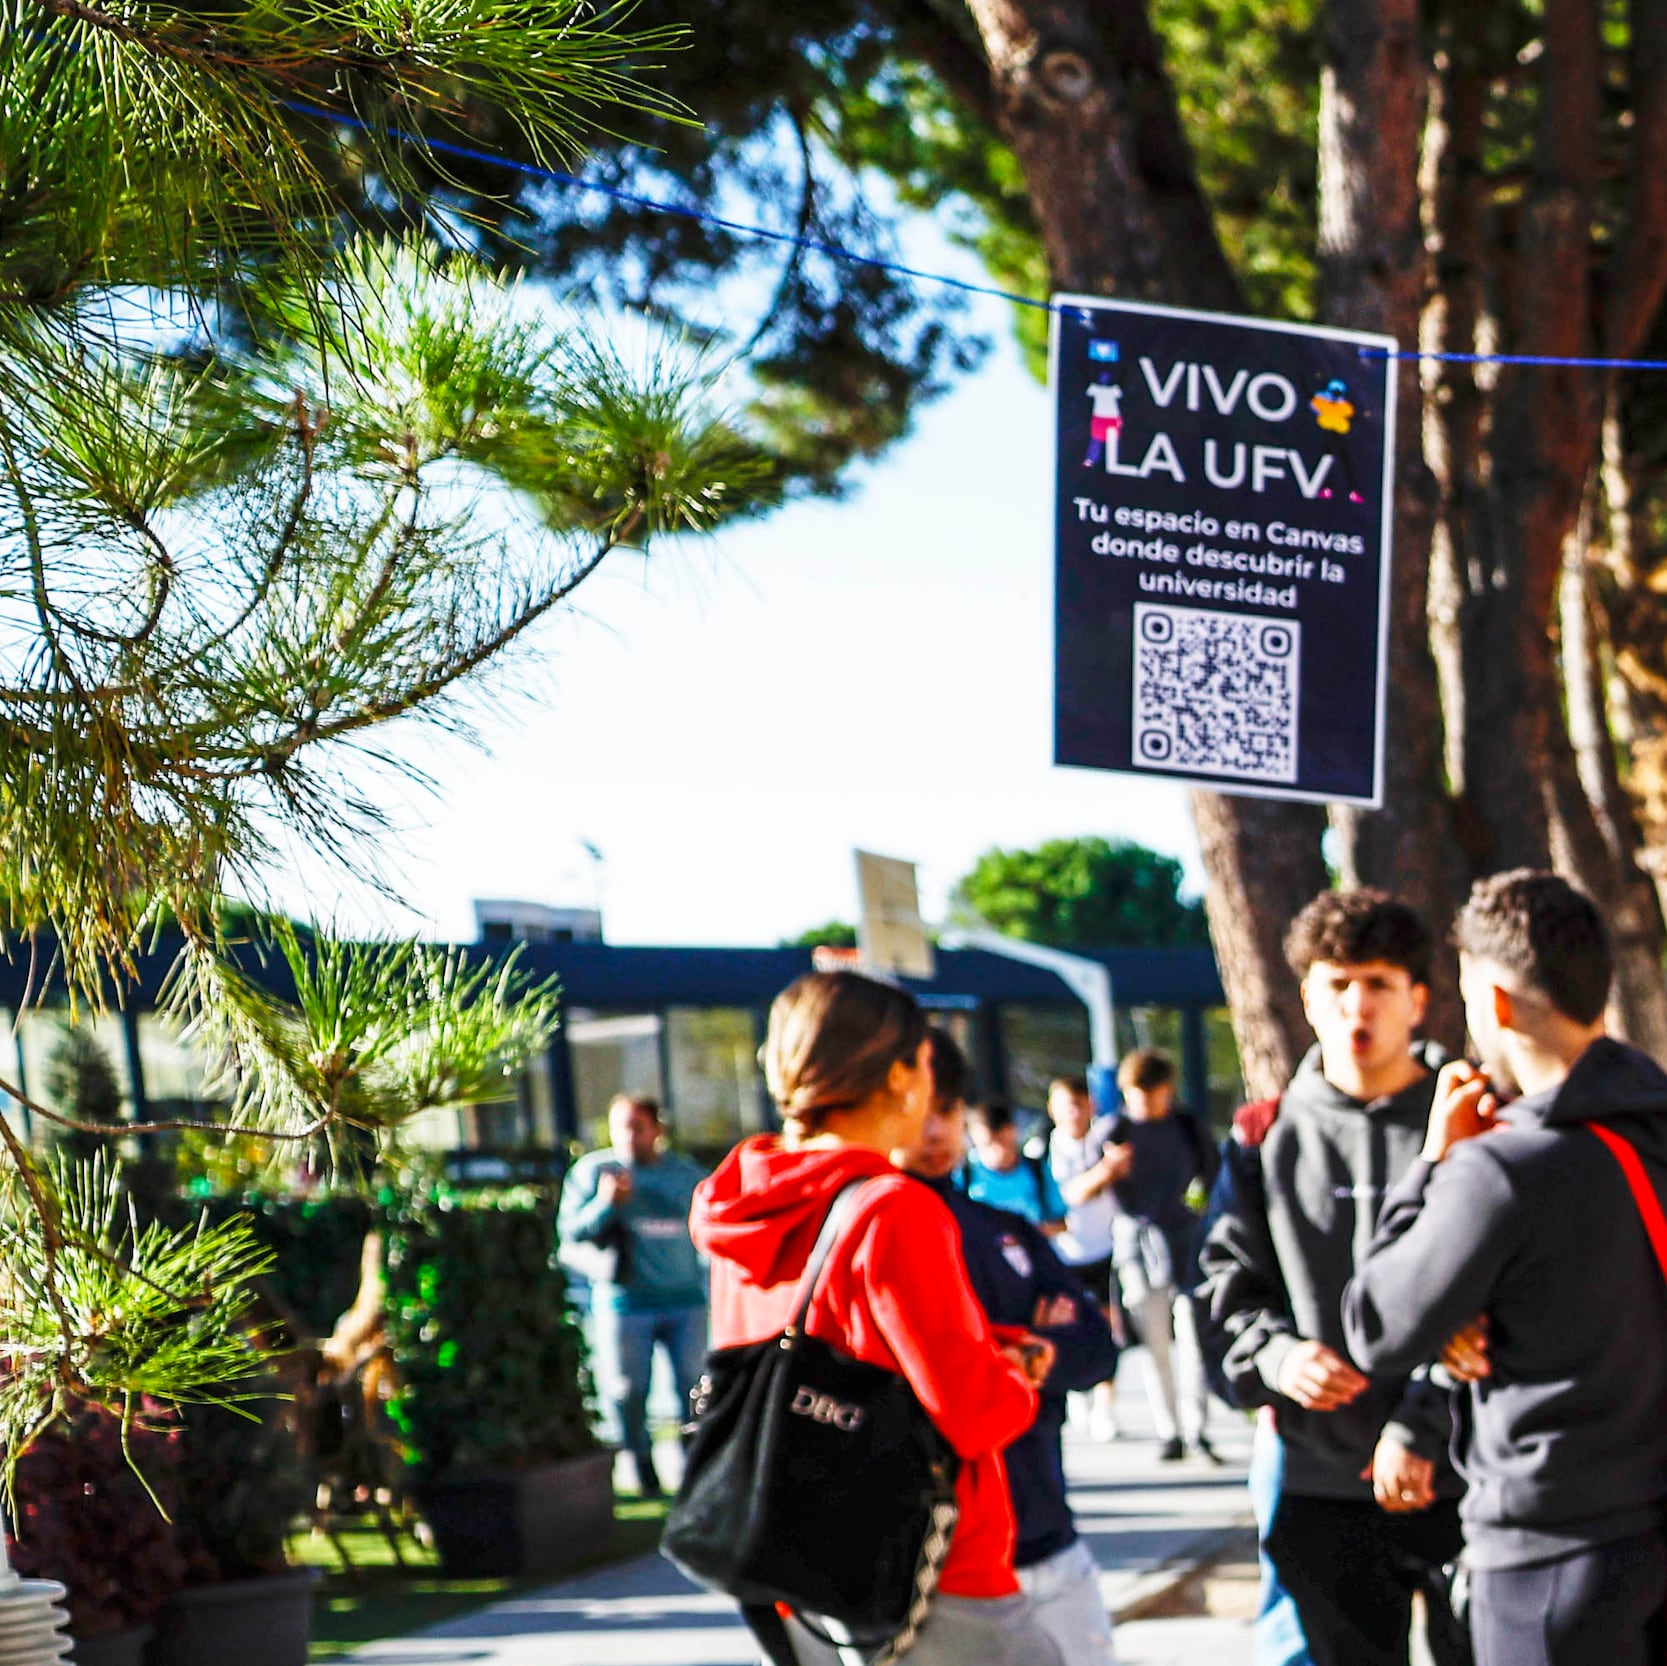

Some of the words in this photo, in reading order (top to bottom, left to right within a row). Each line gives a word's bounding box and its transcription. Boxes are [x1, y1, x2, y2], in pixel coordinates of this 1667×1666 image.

[1139, 357, 1297, 422] VIVO
[1106, 426, 1186, 483] LA
[1205, 439, 1334, 499] UFV
[1074, 497, 1109, 524] Tu
[1114, 502, 1219, 537] espacio
[1225, 519, 1260, 543] en
[1266, 520, 1366, 556] Canvas
[1092, 532, 1180, 564] donde
[1185, 543, 1318, 579] descubrir
[1321, 557, 1345, 584] la
[1139, 569, 1298, 609] universidad
